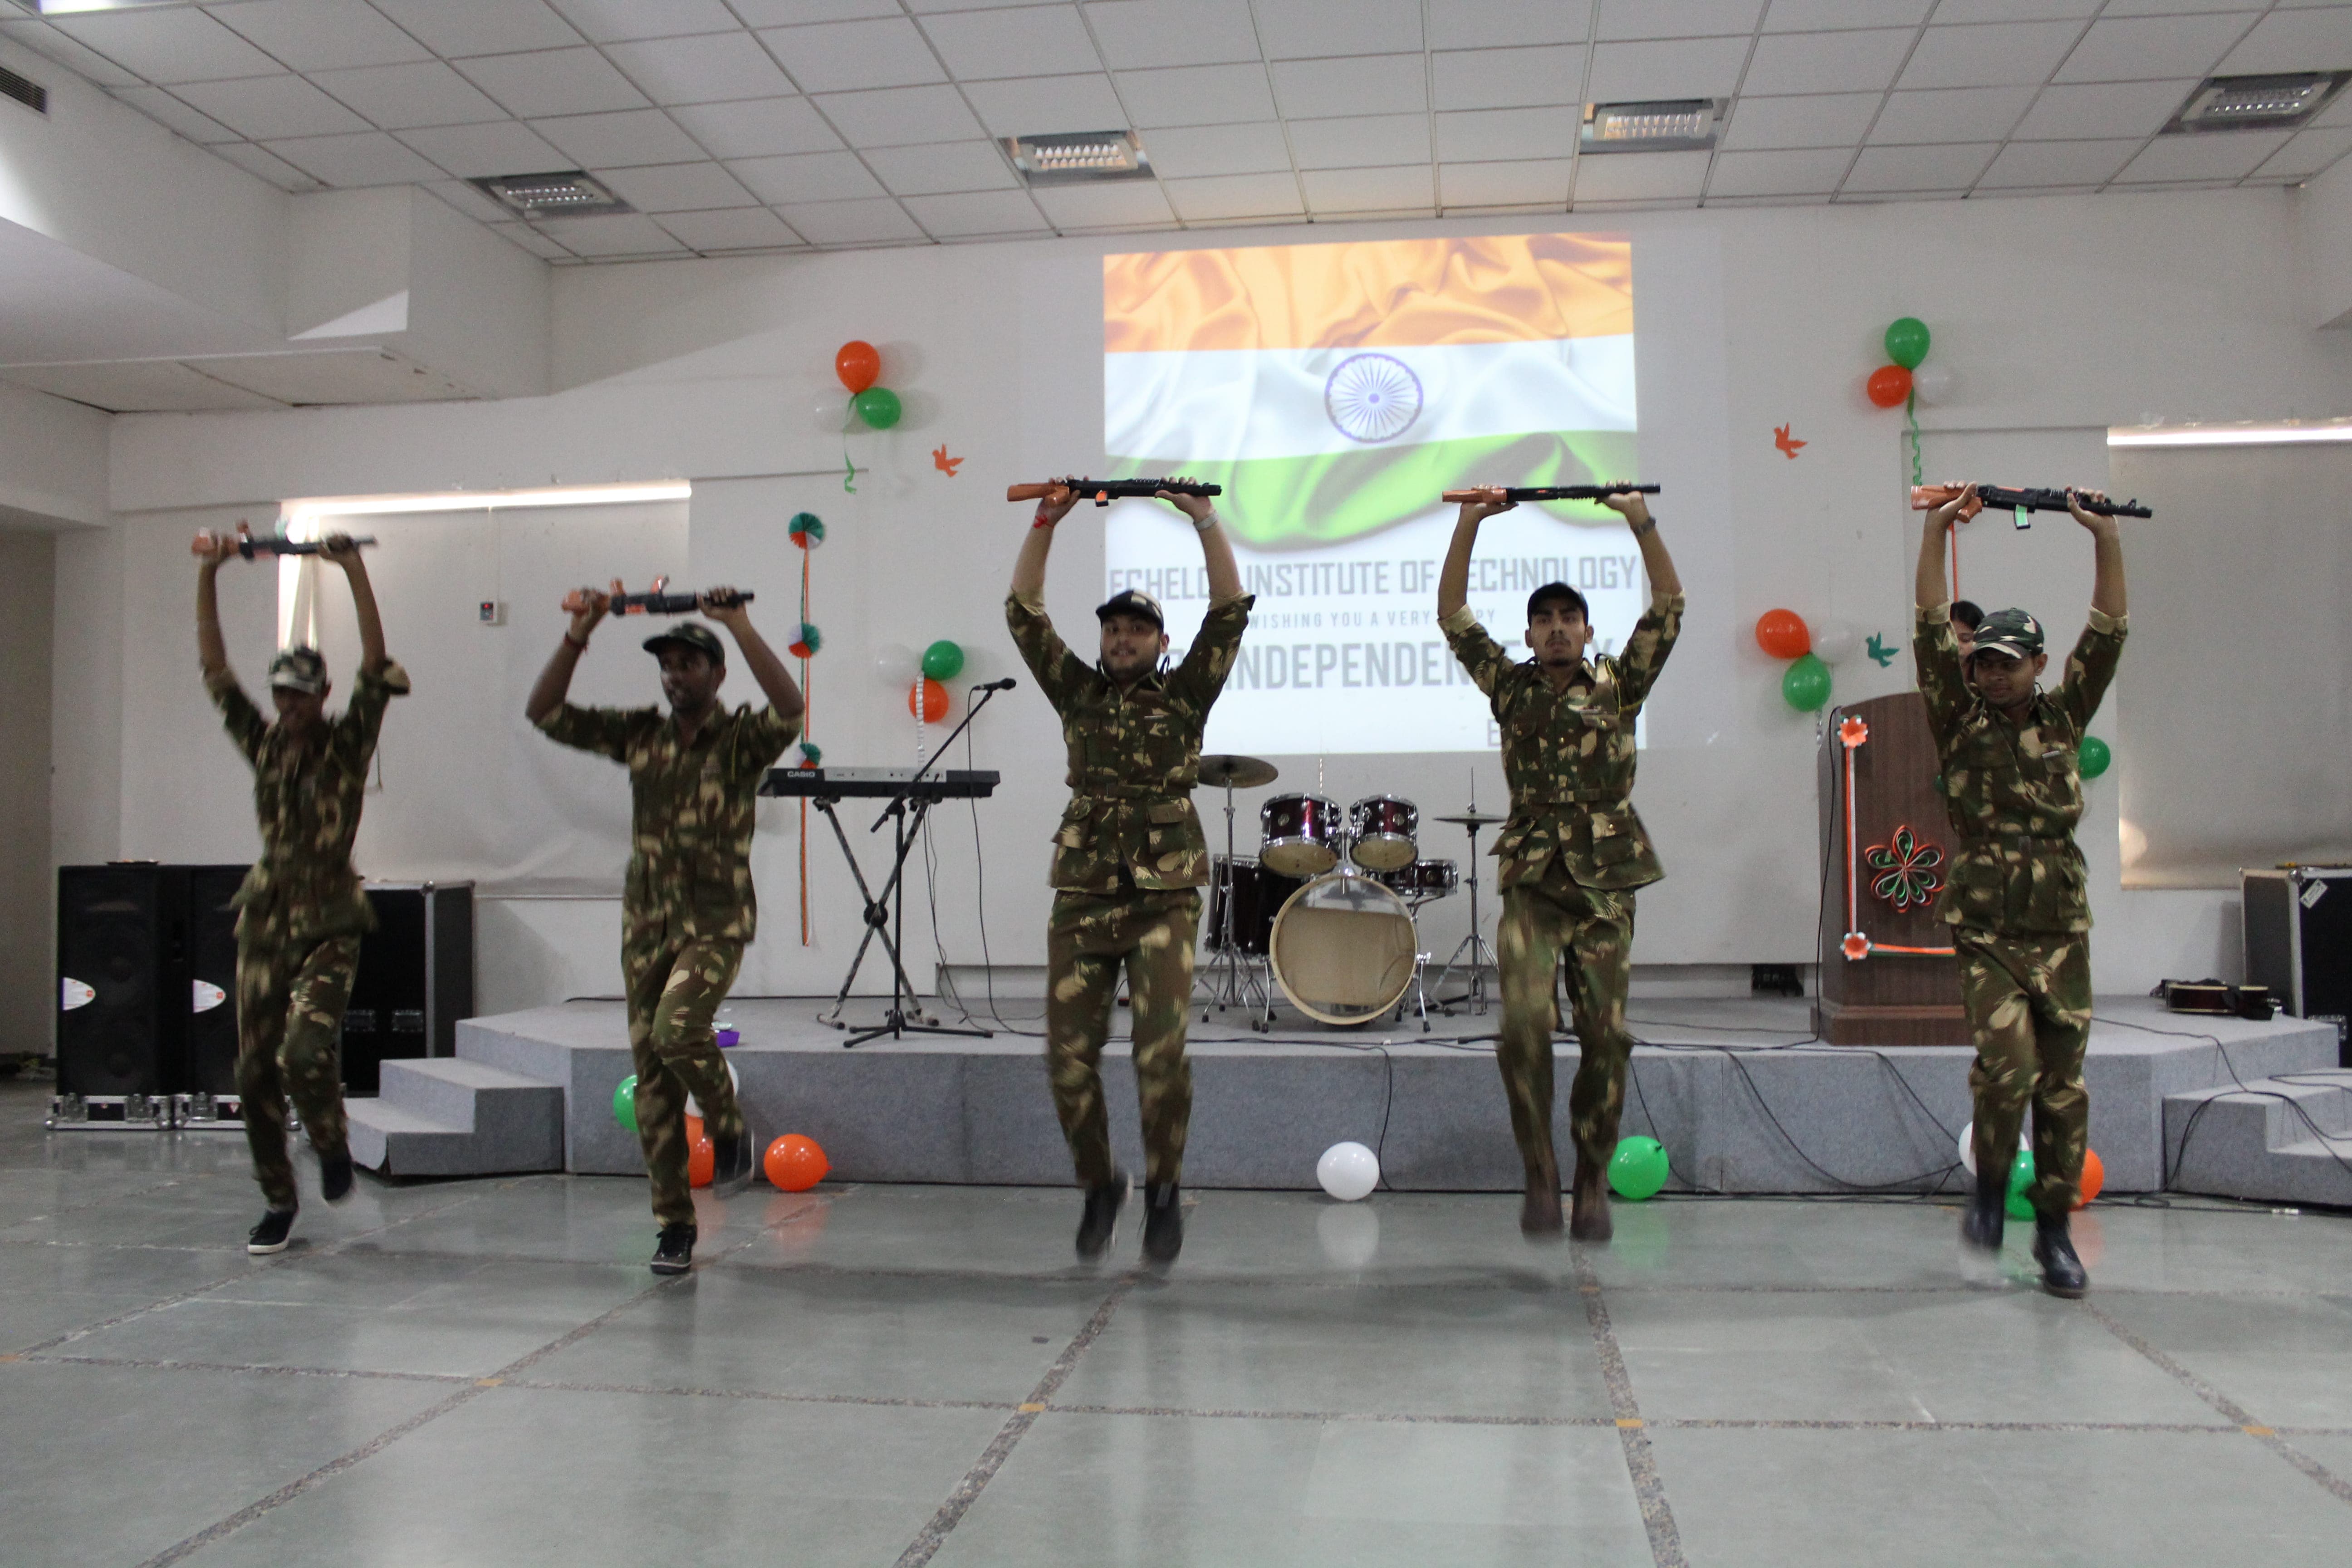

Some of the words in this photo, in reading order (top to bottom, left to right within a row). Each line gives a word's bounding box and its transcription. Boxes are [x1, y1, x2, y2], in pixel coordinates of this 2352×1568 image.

[1111, 567, 1209, 600] ECHELO
[1246, 561, 1389, 597] INSTITUTE
[1401, 560, 1435, 594] OF
[1468, 556, 1637, 592] ECHNOLOGY
[1249, 612, 1322, 629] WISHING
[1330, 612, 1362, 627] YOU
[1370, 611, 1379, 626] A
[1387, 610, 1431, 626] VERY
